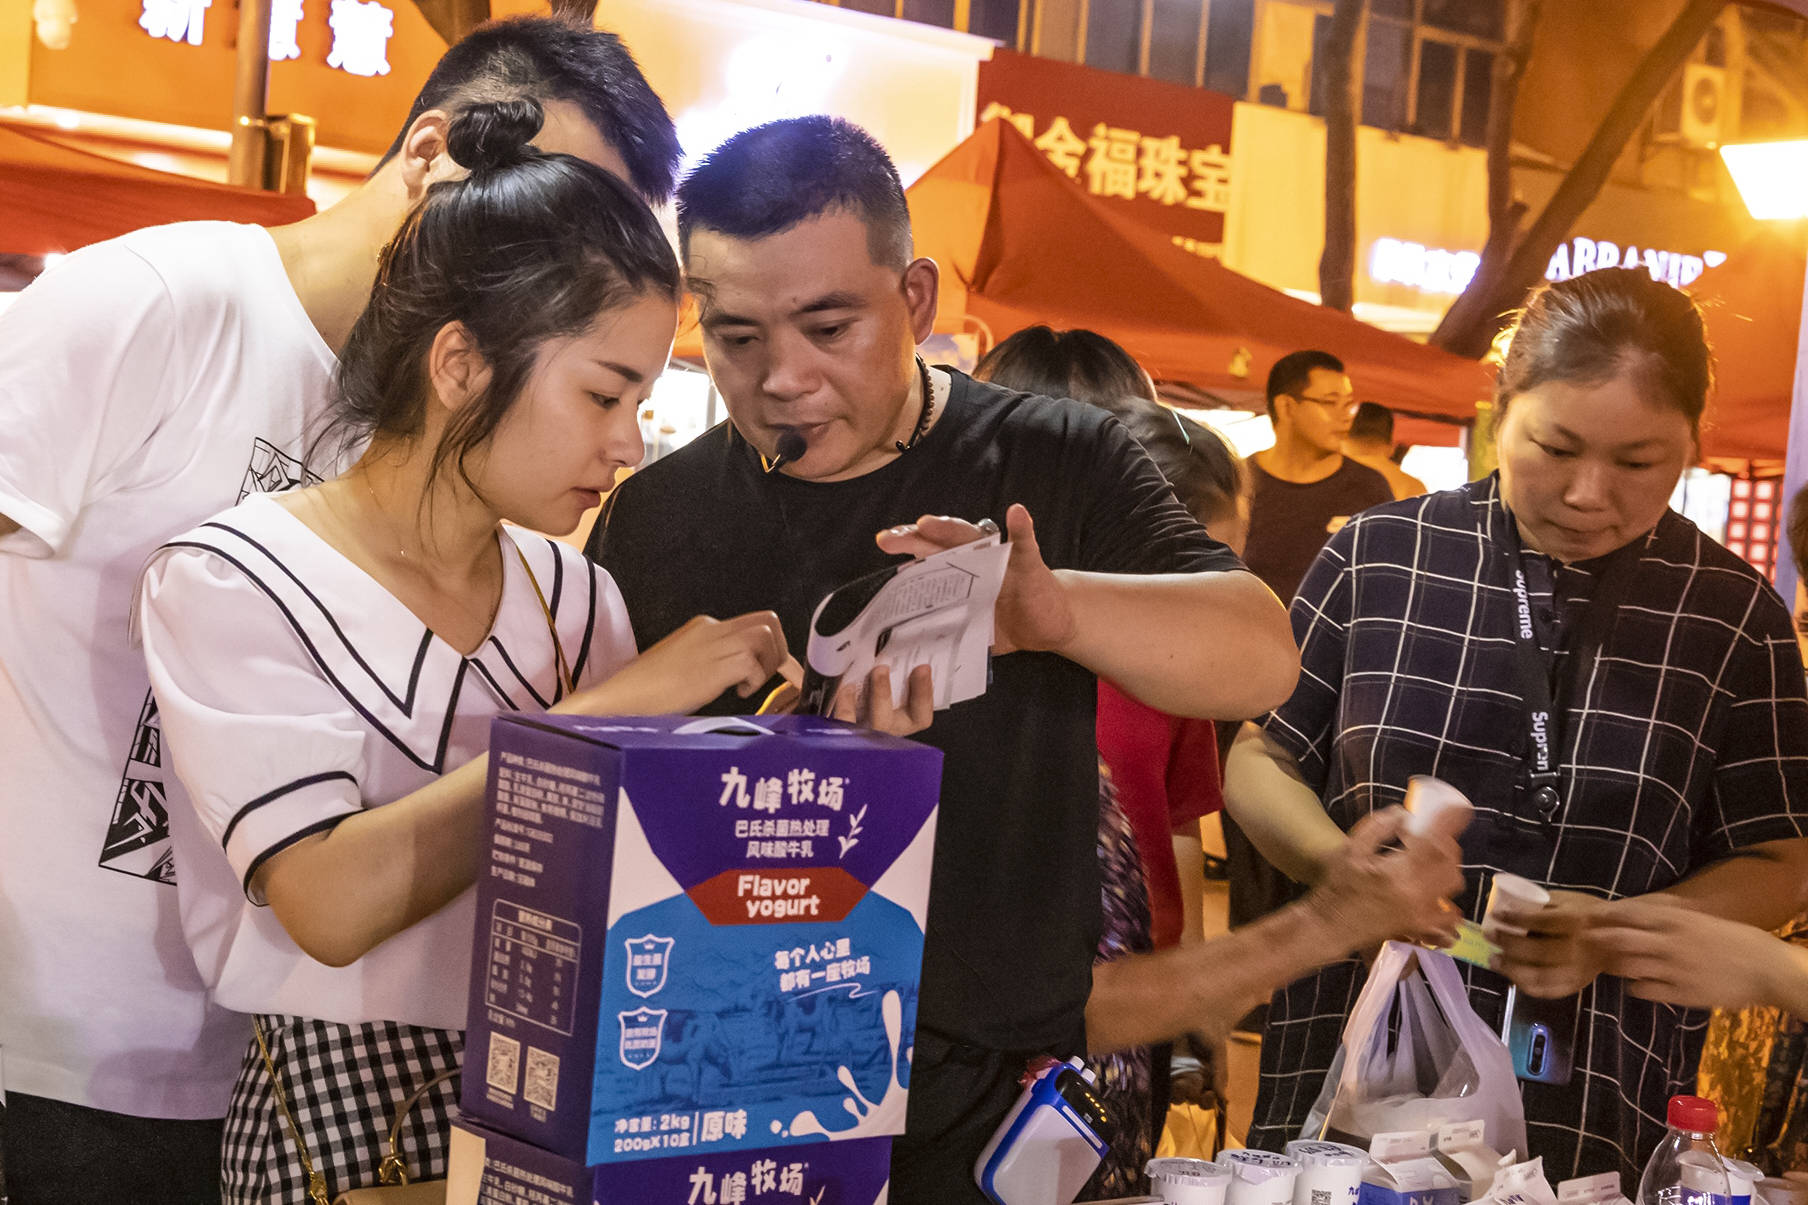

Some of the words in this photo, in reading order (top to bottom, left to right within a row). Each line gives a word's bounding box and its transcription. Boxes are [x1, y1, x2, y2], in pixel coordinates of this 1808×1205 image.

[719, 766, 845, 814] 九峰牧场
[735, 819, 830, 838] 巴氏杀菌热处理
[746, 840, 814, 858] 风味酸牛乳
[737, 874, 810, 897] Flavor
[746, 895, 820, 918] yogurt
[701, 1108, 748, 1142] 原味
[688, 1159, 804, 1205] 九峰牧场
